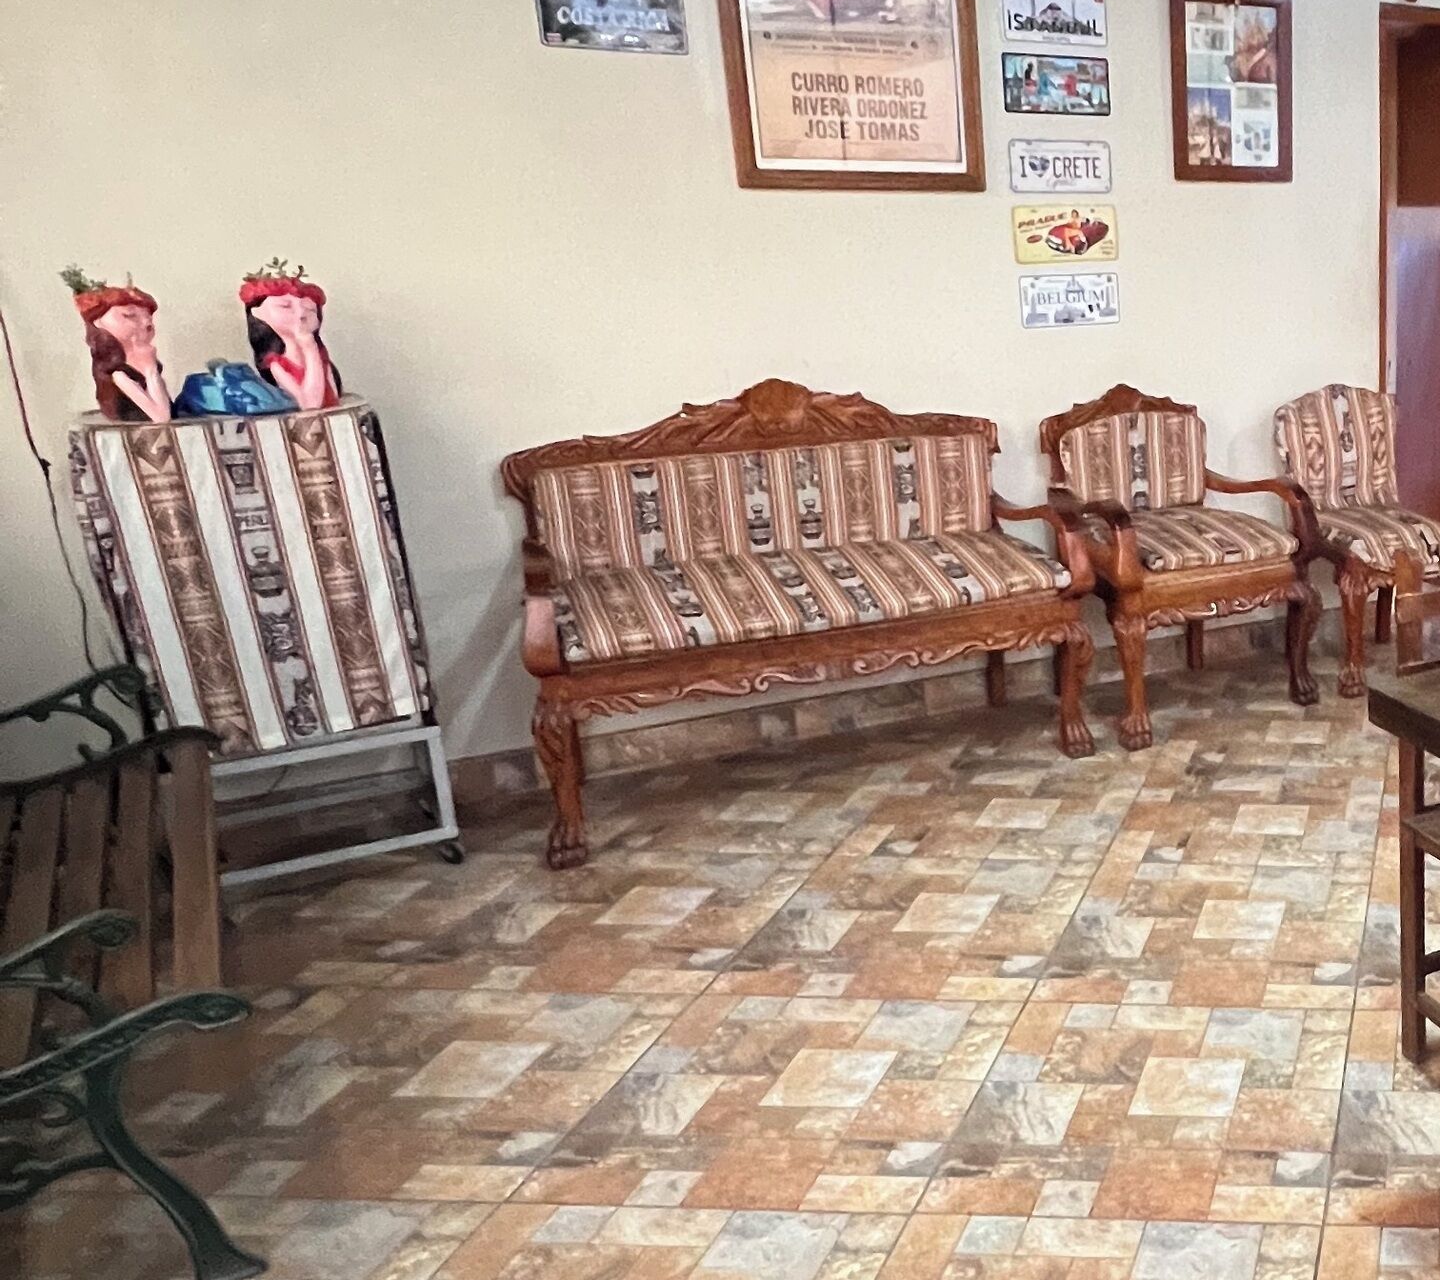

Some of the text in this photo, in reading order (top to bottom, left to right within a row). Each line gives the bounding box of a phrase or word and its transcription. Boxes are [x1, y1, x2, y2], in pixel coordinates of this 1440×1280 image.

[791, 71, 925, 99] CURRO ROMERO
[791, 95, 852, 118] RIVERA
[1019, 155, 1101, 180] I CRETE
[1037, 290, 1105, 306] BELGIUM
